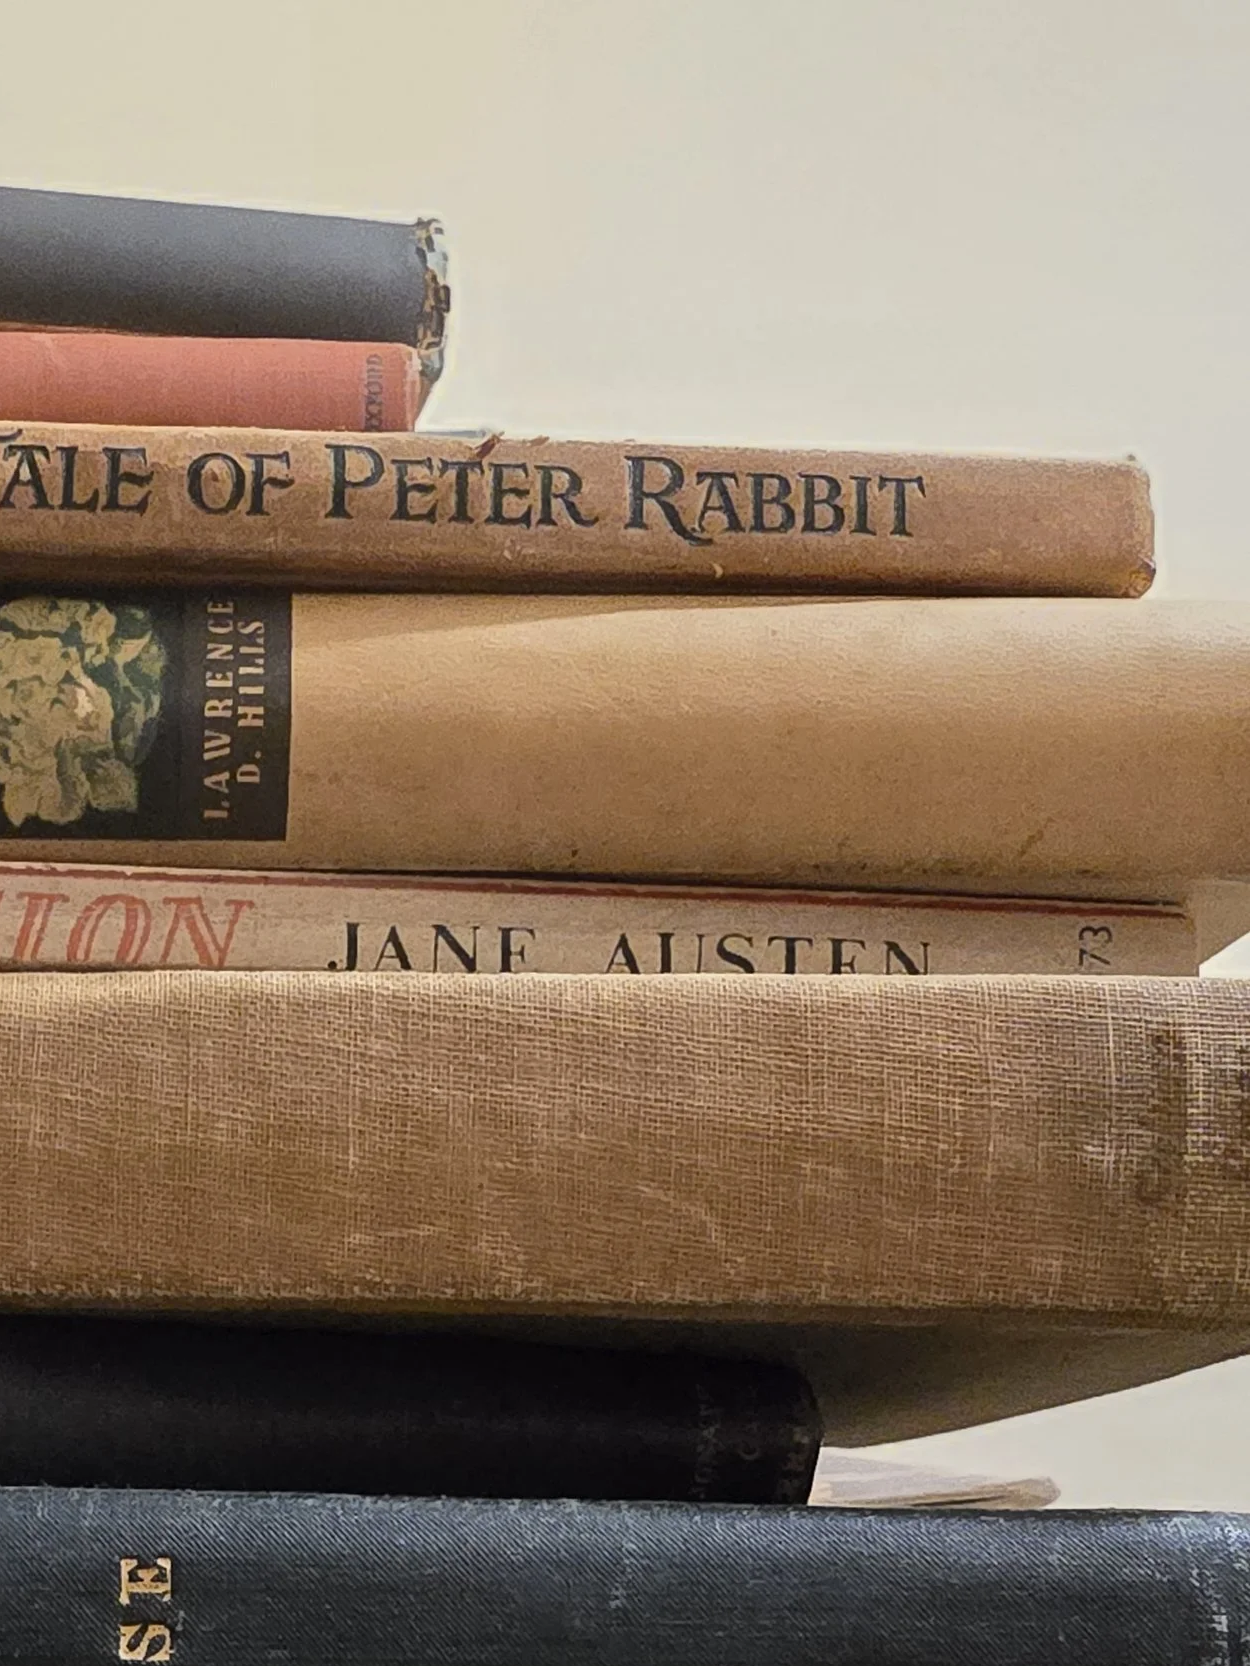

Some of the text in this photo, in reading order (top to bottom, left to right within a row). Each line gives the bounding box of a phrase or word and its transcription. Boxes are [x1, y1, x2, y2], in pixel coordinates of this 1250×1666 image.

[186, 449, 295, 519] OF
[323, 441, 600, 531] PETER
[622, 453, 928, 548] RABBIT
[203, 600, 235, 820] LAWRENCE
[236, 620, 266, 785] D. HILLS
[325, 921, 537, 974] JANE
[606, 932, 931, 976] AUSTEN
[1077, 923, 1114, 968] 73
